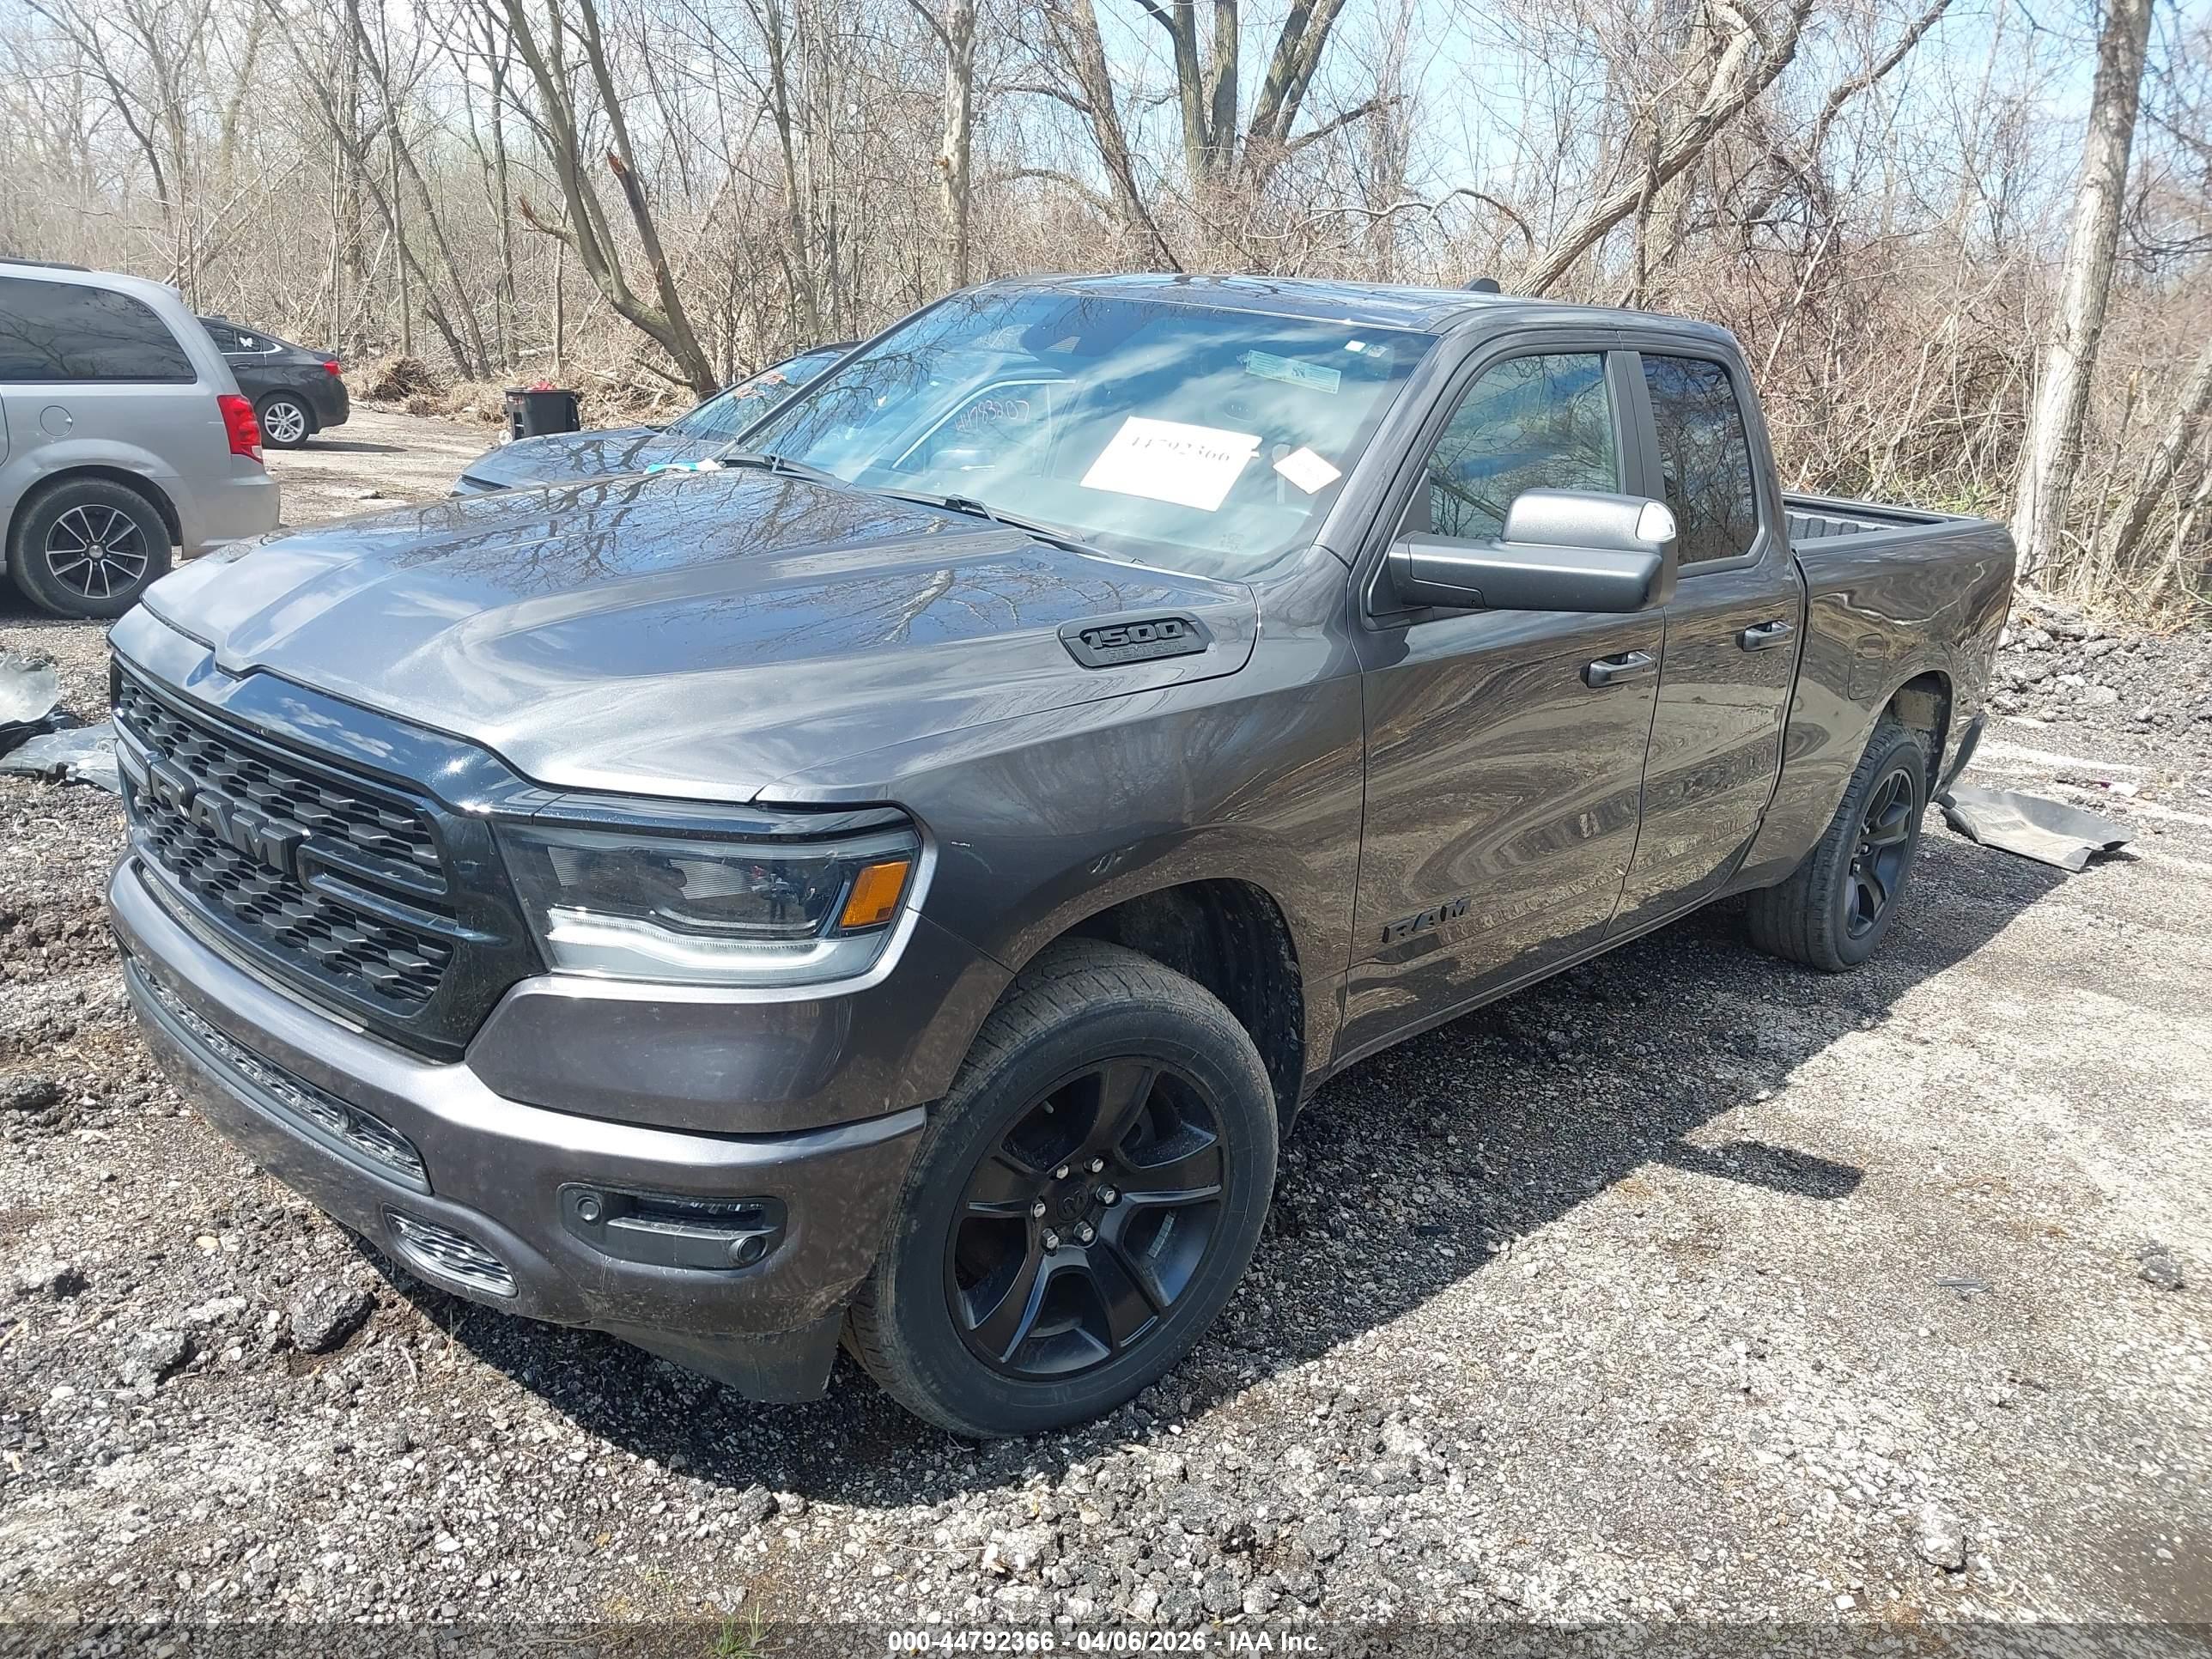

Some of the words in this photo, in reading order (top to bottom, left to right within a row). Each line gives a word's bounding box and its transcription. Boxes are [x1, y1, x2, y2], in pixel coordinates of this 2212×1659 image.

[1083, 620, 1184, 649] 1500
[1105, 645, 1152, 661] HEMI
[150, 760, 295, 875] RAM
[1382, 893, 1471, 943] RAM
